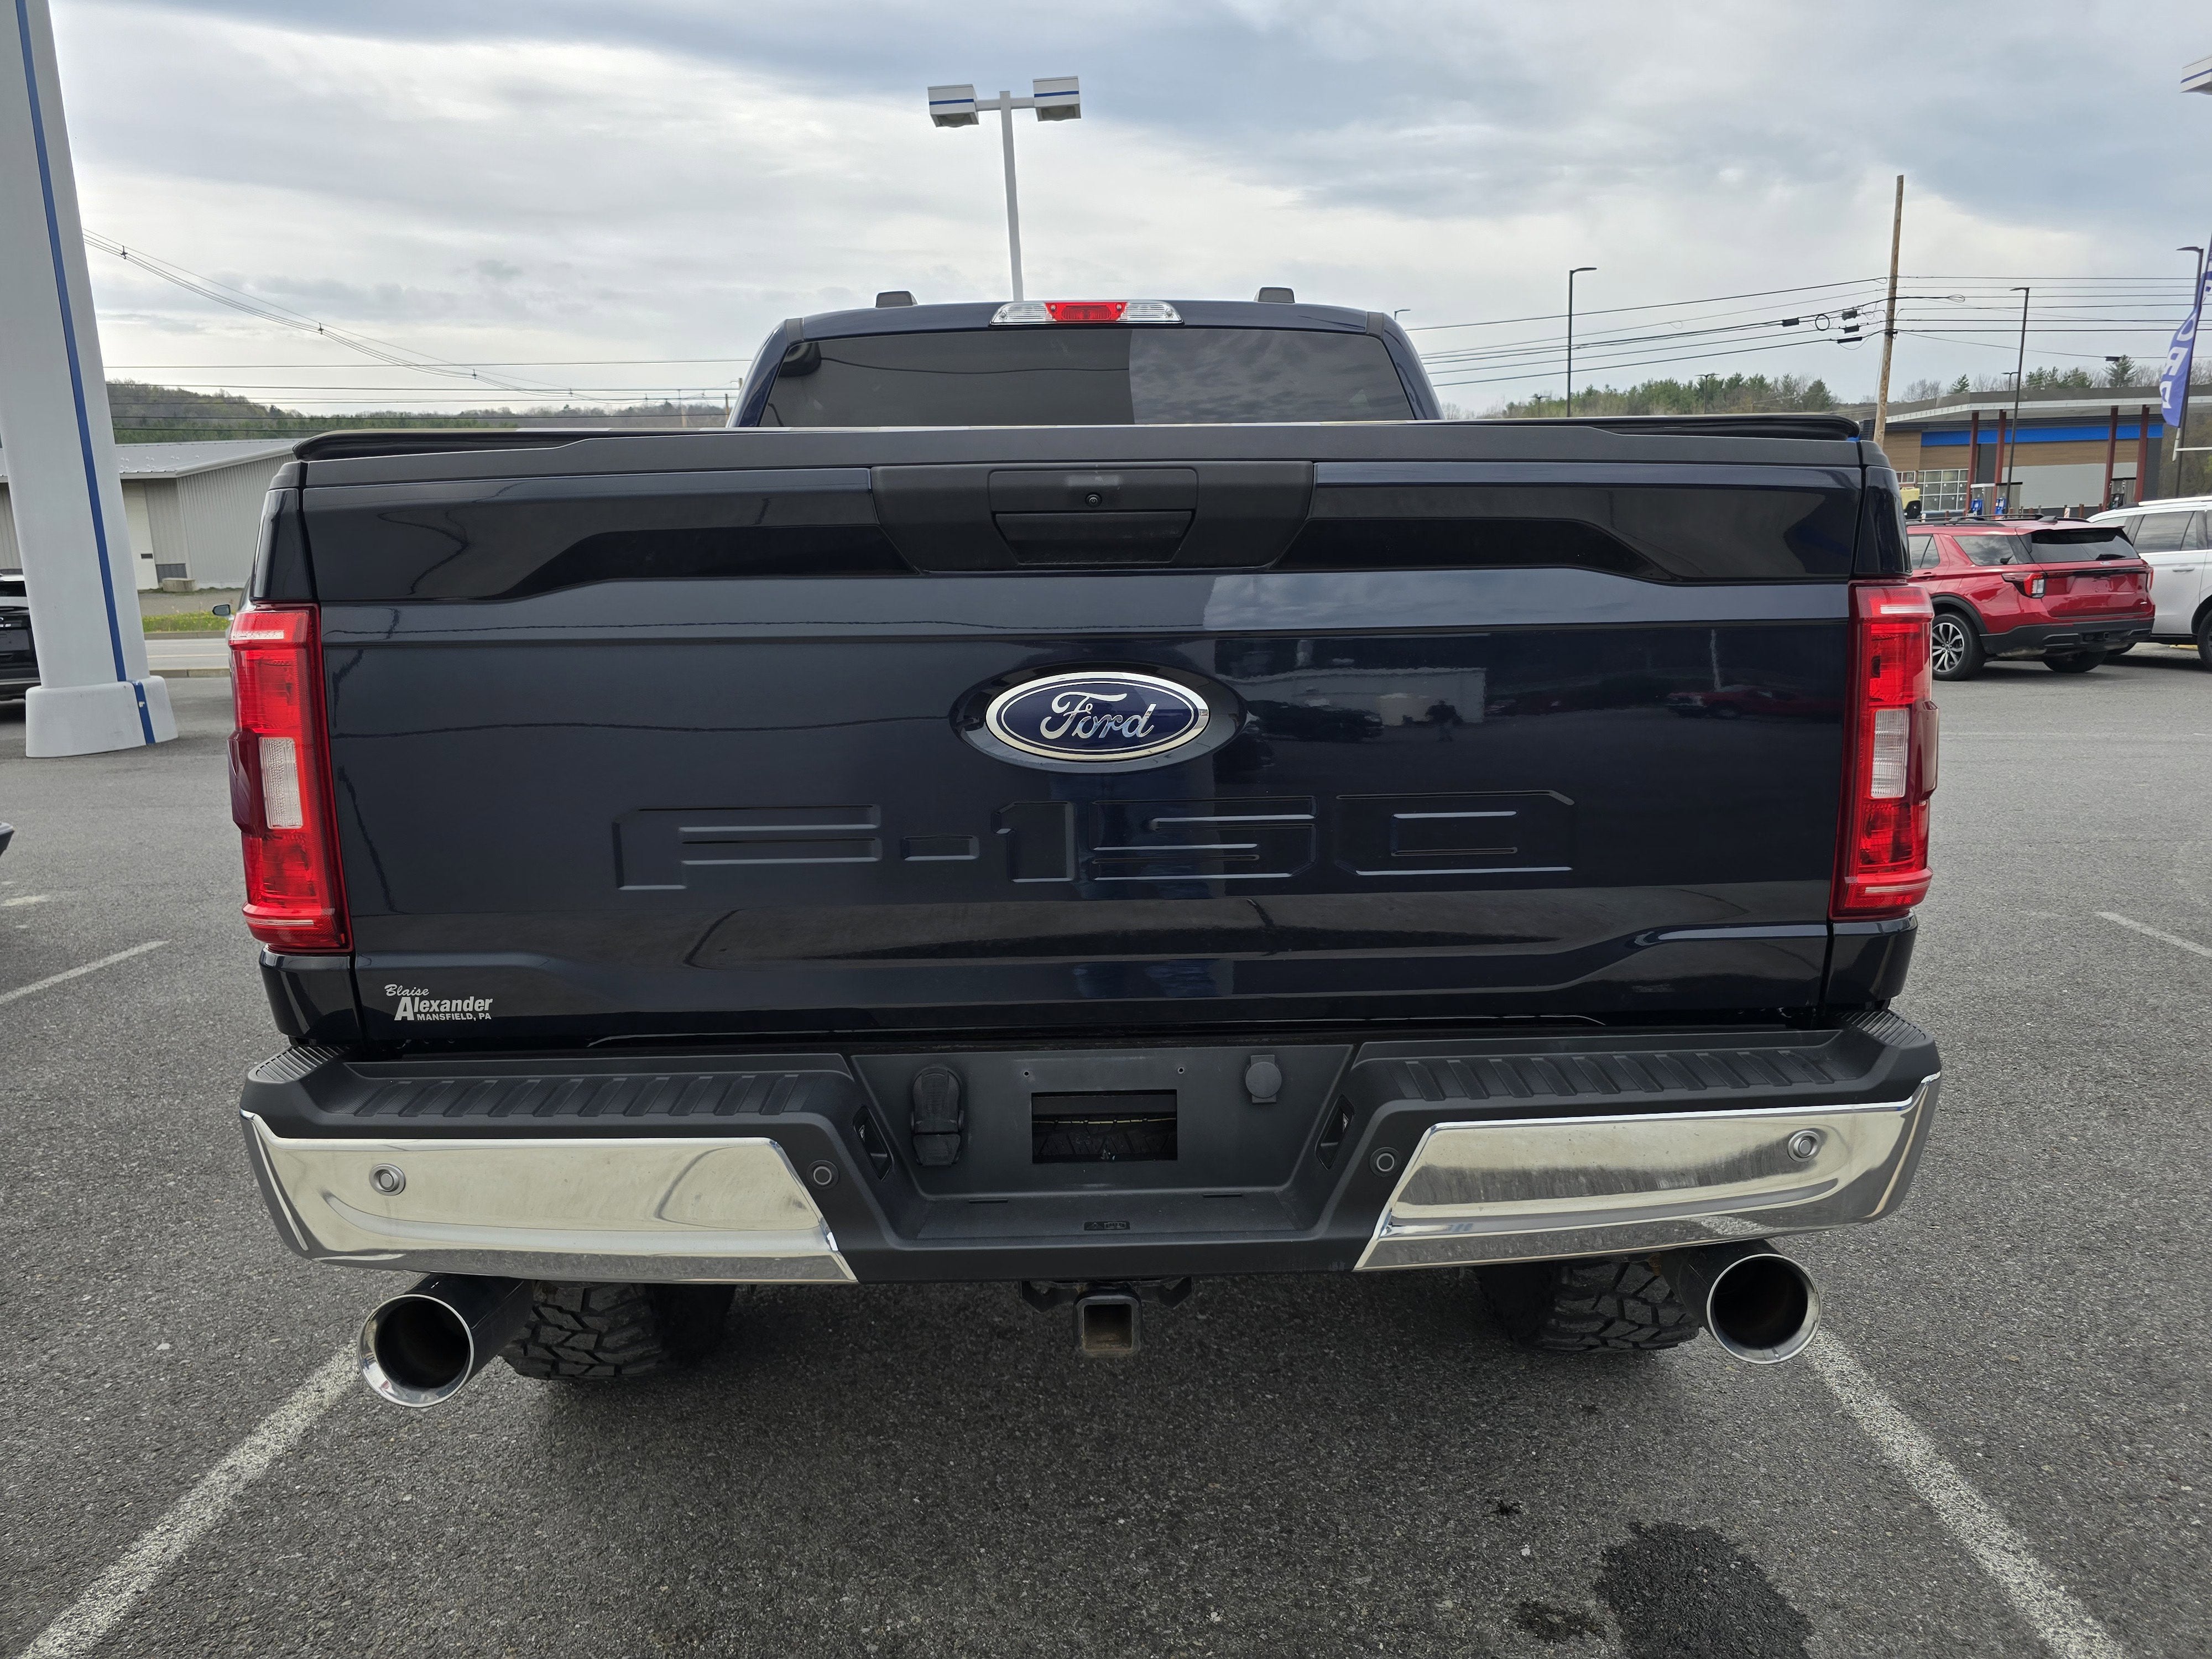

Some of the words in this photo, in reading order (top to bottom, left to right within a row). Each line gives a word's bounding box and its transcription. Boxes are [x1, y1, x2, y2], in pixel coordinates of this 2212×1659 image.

[1040, 691, 1155, 740] Ford
[613, 791, 1576, 890] F-150
[384, 984, 430, 997] Blaise
[394, 996, 493, 1021] Alexander
[417, 1013, 476, 1021] MANSFIELD,
